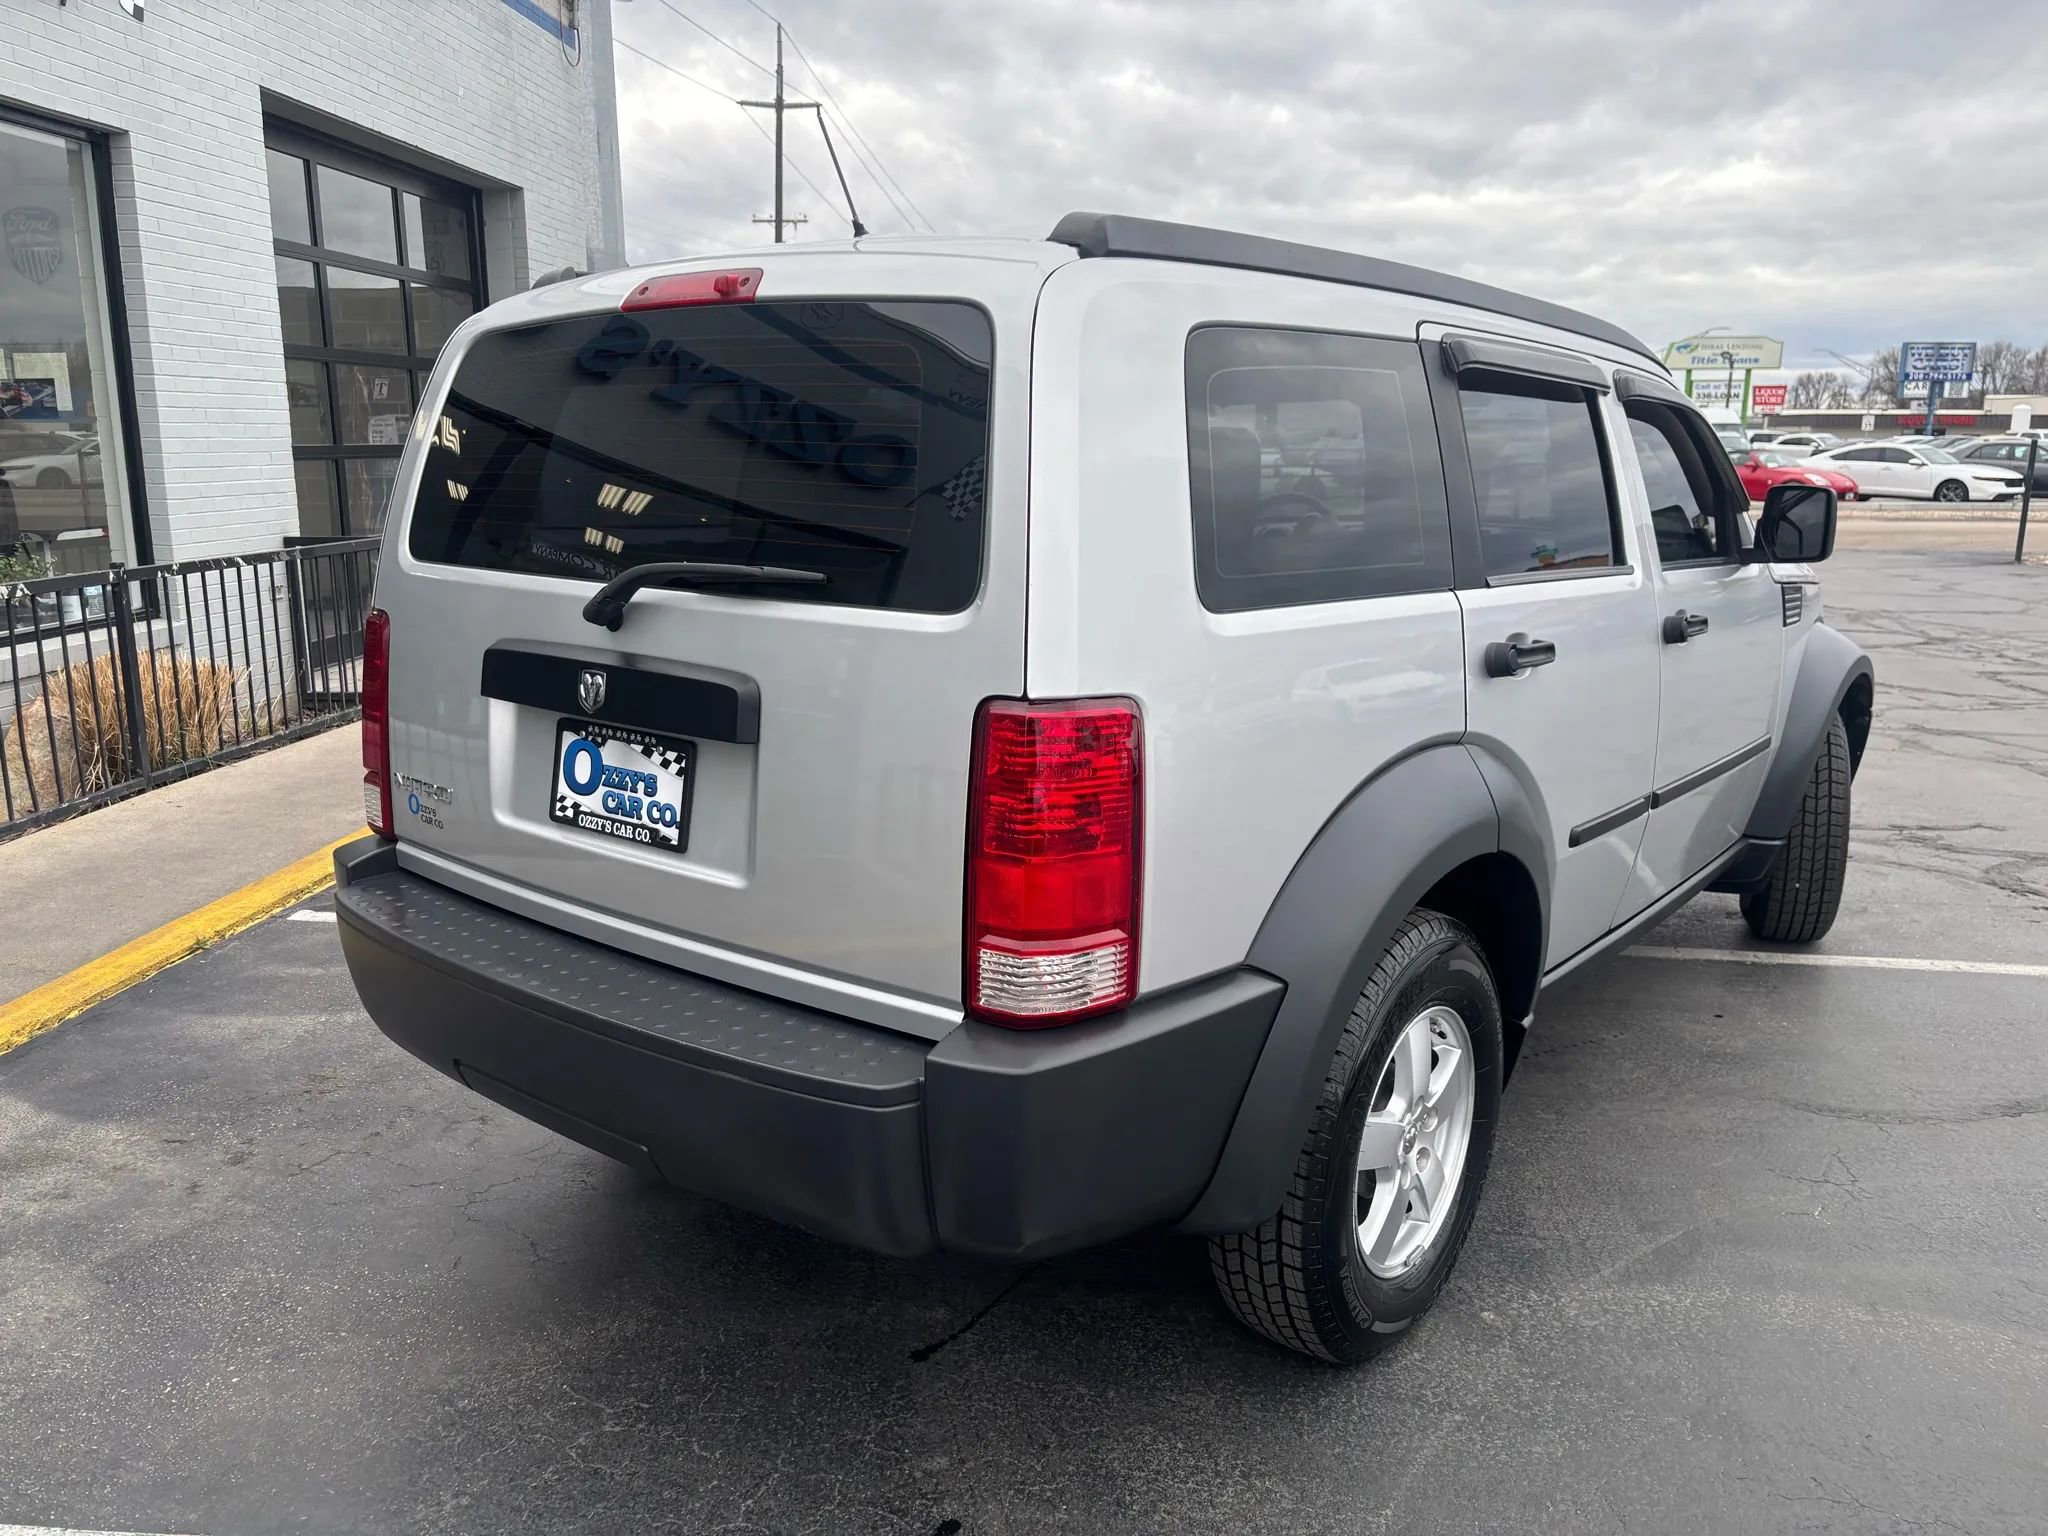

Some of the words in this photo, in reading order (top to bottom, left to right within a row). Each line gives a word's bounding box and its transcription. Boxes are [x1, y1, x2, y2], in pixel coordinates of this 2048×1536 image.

[1755, 387, 1785, 396] LIQUOR
[1755, 396, 1783, 404] STORE
[563, 738, 658, 797] OZZY'S
[602, 790, 643, 821] CAR
[578, 813, 612, 834] OZZY'S
[613, 822, 634, 839] CAR
[635, 827, 652, 843] CO.
